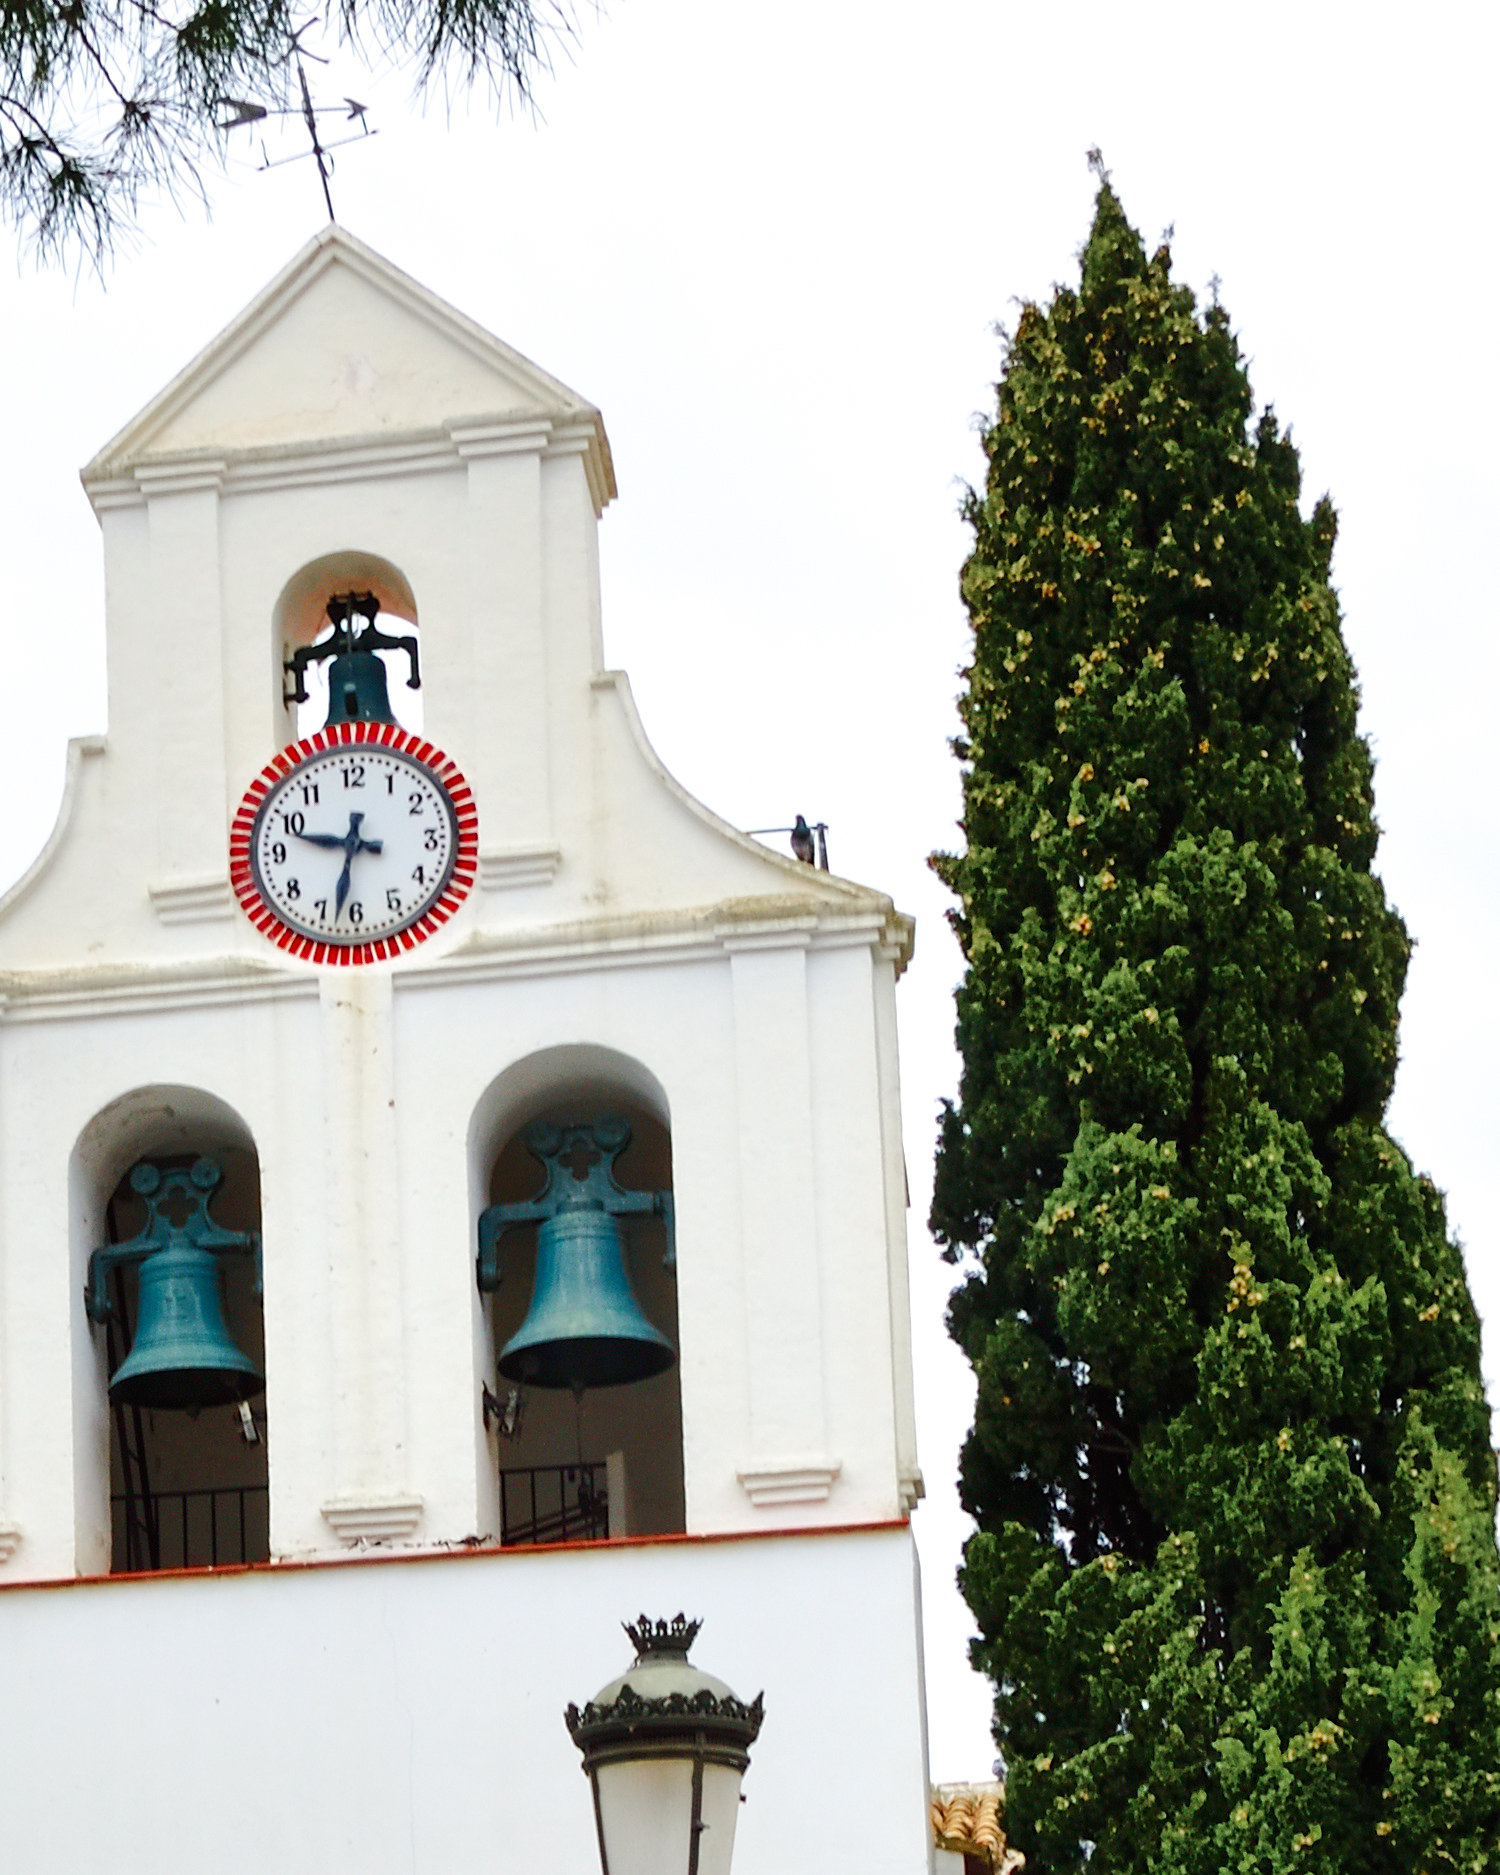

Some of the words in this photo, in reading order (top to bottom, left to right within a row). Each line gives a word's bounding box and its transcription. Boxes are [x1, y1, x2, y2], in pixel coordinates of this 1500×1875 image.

[341, 766, 365, 789] 12
[385, 774, 395, 795] 1
[302, 784, 320, 806] 11
[408, 793, 424, 816] 2
[283, 812, 305, 835] 10
[424, 829, 438, 850] 3
[271, 842, 287, 864] 9
[412, 865, 425, 885] 4
[286, 878, 301, 900] 8
[386, 889, 401, 911] 5
[314, 900, 328, 921] 7
[348, 902, 363, 924] 6
